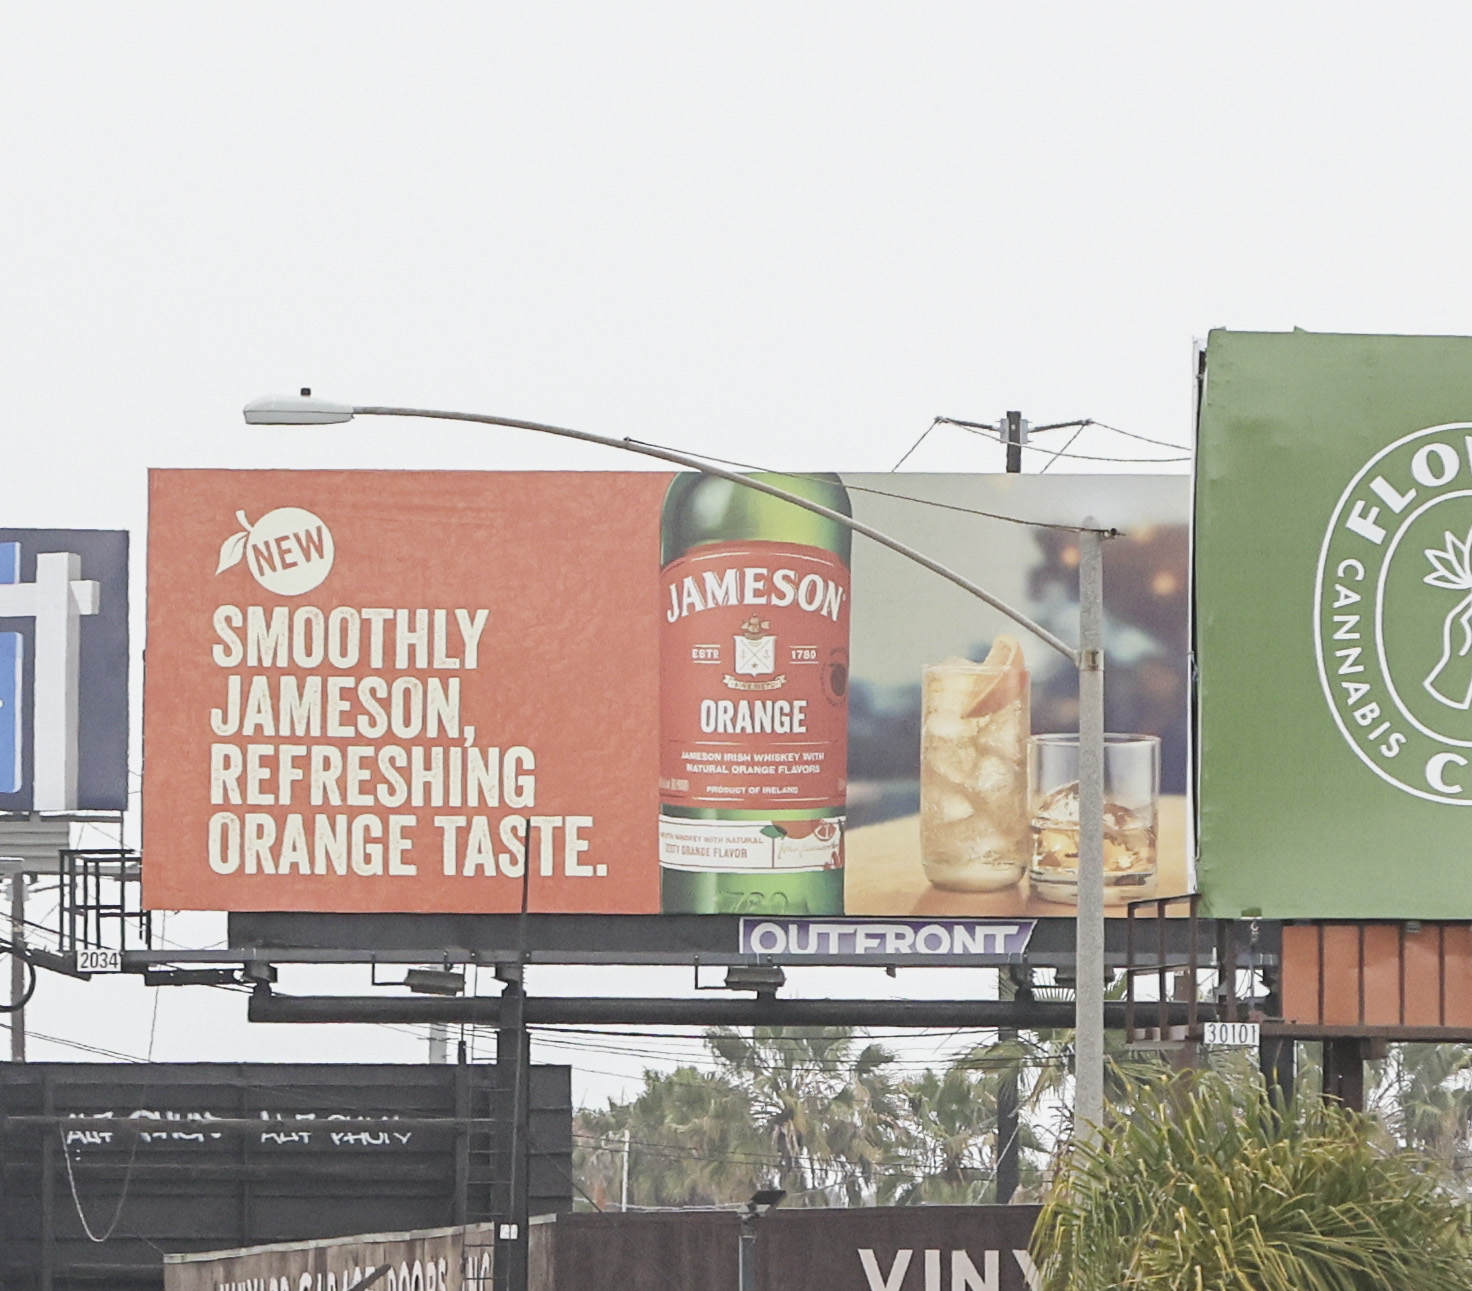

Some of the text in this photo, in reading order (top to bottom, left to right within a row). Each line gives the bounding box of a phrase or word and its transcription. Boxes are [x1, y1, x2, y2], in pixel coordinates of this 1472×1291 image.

[252, 525, 324, 577] NEW
[667, 567, 843, 623] JAMESON
[213, 605, 489, 669] SMOOTHLY
[1333, 559, 1406, 758] CANNABIS
[211, 676, 476, 748] JAMESON,
[701, 700, 806, 733] ORANGE
[687, 764, 729, 774] NATURAL
[732, 765, 776, 774] ORANGE
[724, 753, 751, 761] IRISH
[754, 753, 800, 762] WHISKEY
[803, 753, 825, 761] WITH
[211, 743, 535, 808] REFRESHING
[706, 786, 745, 794] PRODUCT
[209, 812, 608, 877] ORANGE TASTE.
[681, 845, 711, 857] ORANGE
[713, 848, 748, 859] FLAVOR
[750, 922, 1019, 954] OUTFRONT
[80, 951, 118, 968] 2034
[1208, 1023, 1256, 1043] 30101
